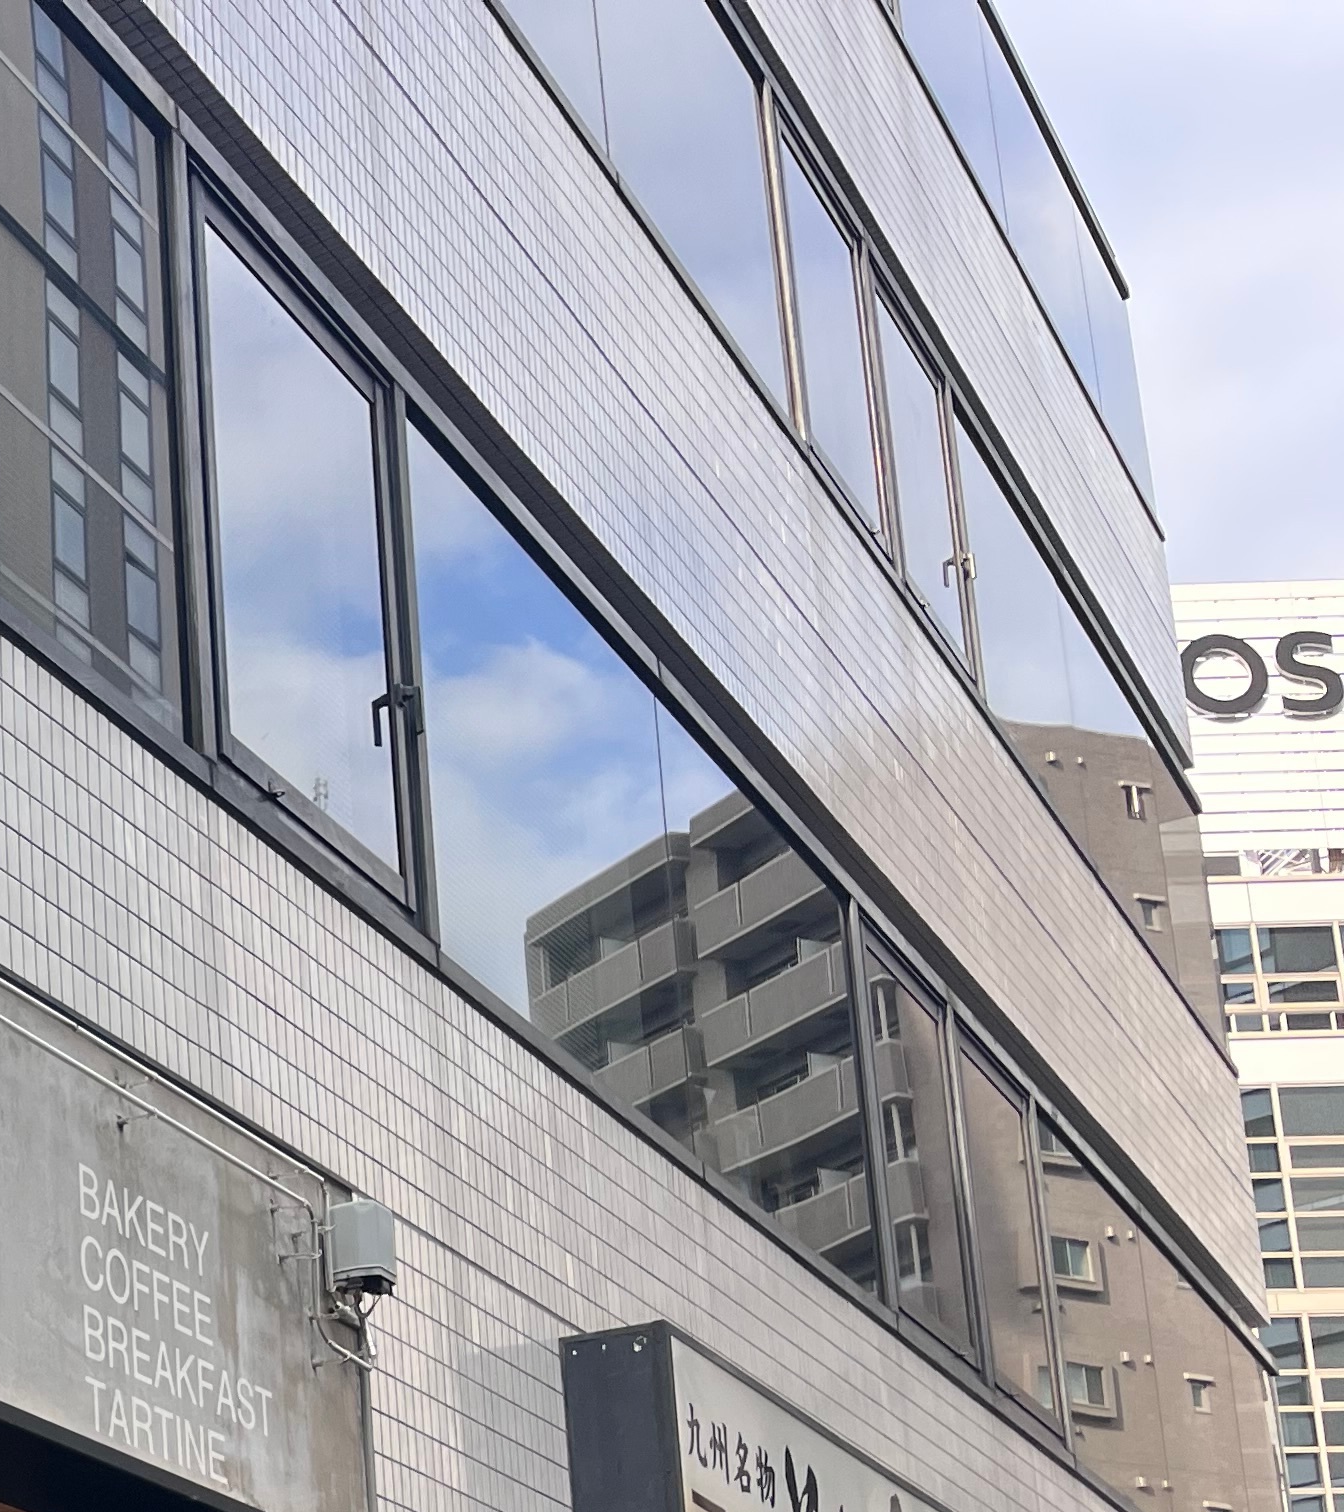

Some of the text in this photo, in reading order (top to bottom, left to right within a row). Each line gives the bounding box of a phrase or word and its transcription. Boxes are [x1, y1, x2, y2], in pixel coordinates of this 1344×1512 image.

[78, 1162, 209, 1277] BAKERY
[80, 1235, 214, 1347] COFFEE
[83, 1305, 273, 1437] BREAKFAST
[85, 1375, 229, 1486] TARTINE
[687, 1403, 775, 1509] 九州名物
